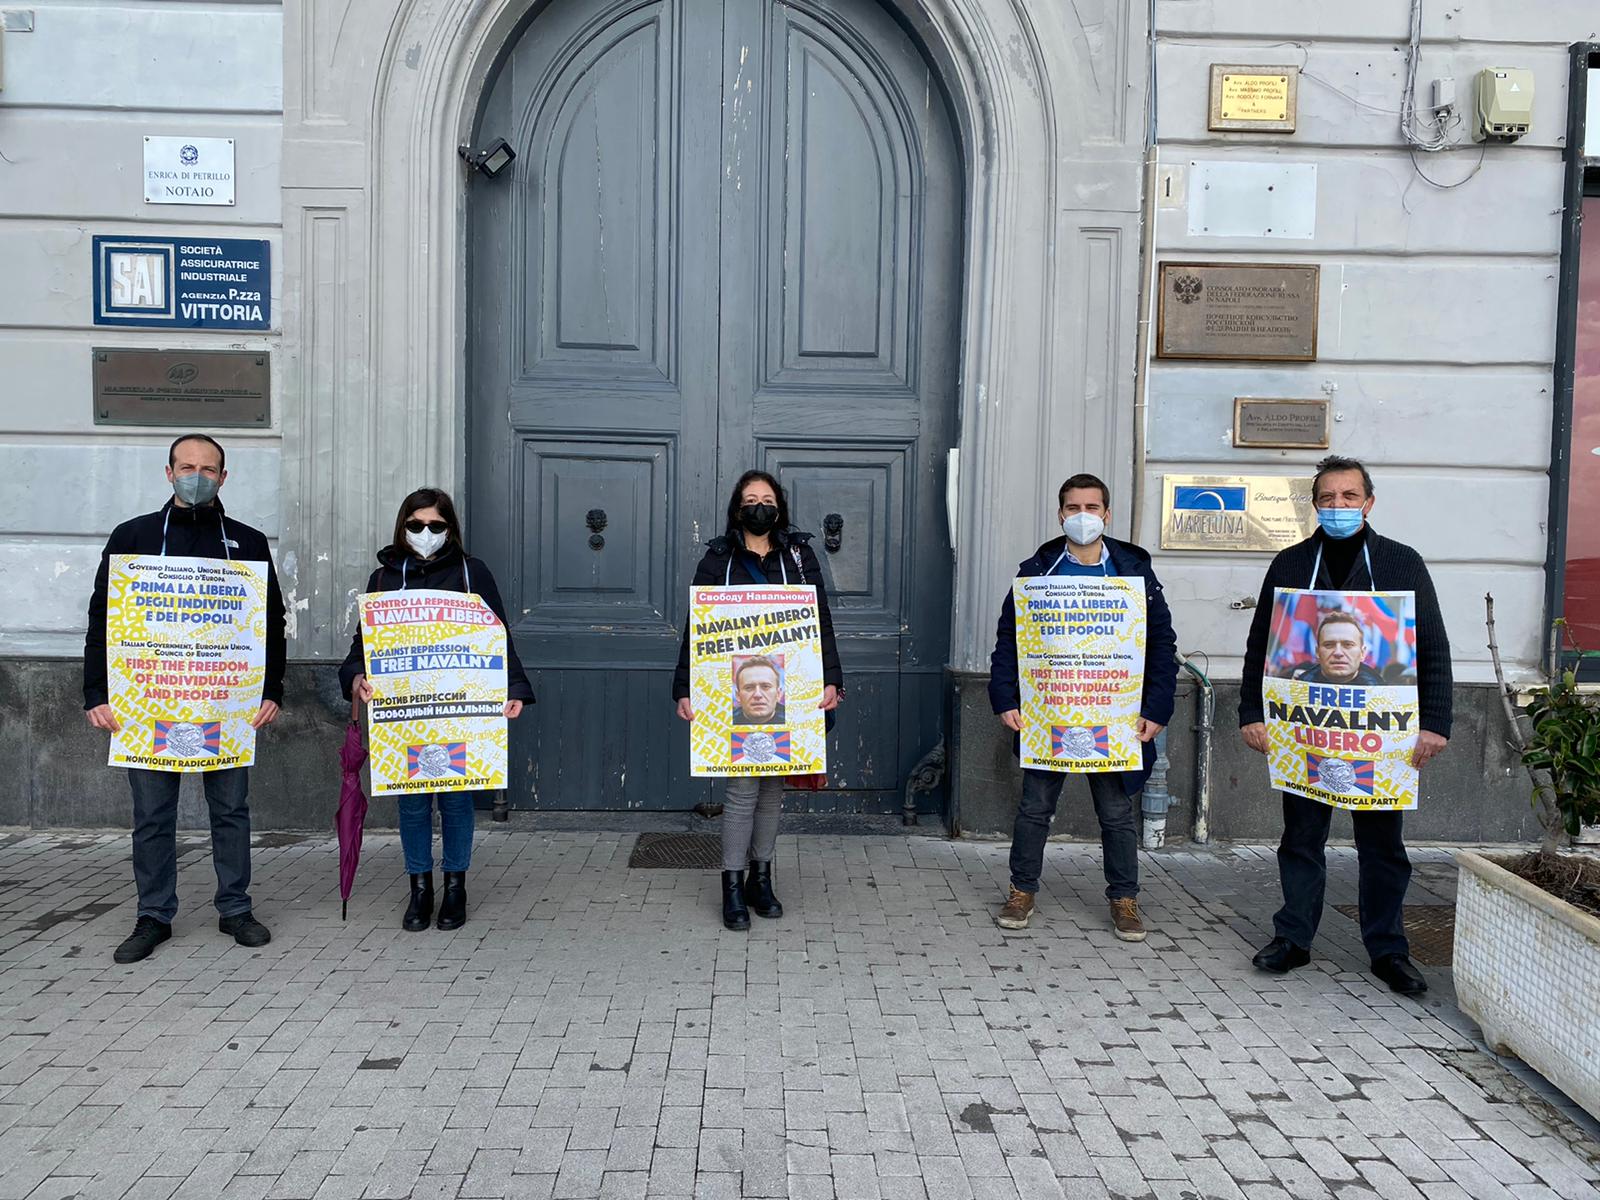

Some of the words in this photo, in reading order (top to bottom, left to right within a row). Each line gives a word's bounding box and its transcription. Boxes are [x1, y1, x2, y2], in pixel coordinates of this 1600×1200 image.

[149, 171, 178, 180] ENRICA
[181, 172, 190, 180] DI
[194, 172, 230, 181] PETRILLO
[166, 186, 214, 197] NOTAIO
[1165, 176, 1171, 197] 1
[180, 245, 222, 255] SOCIETÀ
[180, 259, 259, 269] ASSICURATRICE
[112, 255, 163, 306] SAI
[180, 272, 247, 282] INDUSTRIALE
[181, 292, 227, 300] AGENZIA
[229, 288, 261, 301] P.zza
[181, 303, 263, 321] VITTORIA
[1172, 513, 1244, 534] MARELUNA
[131, 582, 175, 593] PRIMA
[178, 583, 196, 594] LA
[200, 584, 247, 597] LIBERTÀ
[135, 596, 174, 607] DEGLI
[178, 598, 242, 610] INDIVIDUI
[365, 598, 407, 610] CONTRO
[411, 598, 422, 606] LA
[699, 593, 743, 602] Свободу
[747, 593, 813, 602] Навальному!
[1028, 600, 1062, 610] PRIMA
[1064, 600, 1079, 609] LA
[1082, 598, 1128, 609] LIBERTÀ
[146, 611, 152, 621] E
[156, 612, 177, 622] DEI
[181, 613, 232, 624] POPOLI
[374, 608, 440, 624] NAVALNY
[444, 609, 495, 624] LIBERO
[696, 614, 761, 635] NAVALNY
[764, 607, 815, 625] LIBERO!
[1032, 613, 1062, 623] DEGLI
[1064, 613, 1124, 622] INDIVIDUI
[1041, 627, 1045, 635] E
[1048, 626, 1065, 635] DEI
[1068, 626, 1114, 635] POPOLI
[697, 638, 734, 656] FREE
[738, 625, 818, 650] NAVALNY!
[154, 649, 183, 657] COUNCIL
[196, 650, 222, 658] EUROPE
[370, 646, 409, 658] AGAINST
[411, 645, 470, 655] REPRESSION
[126, 658, 158, 670] FIRST
[161, 660, 185, 671] THE
[188, 661, 249, 671] FREEDOM
[380, 658, 413, 673] FREE
[417, 655, 493, 670] NAVALNY
[135, 674, 152, 684] OF
[156, 675, 240, 686] INDIVIDUALS
[1031, 669, 1052, 679] FIRST
[1055, 670, 1074, 679] THE
[1077, 670, 1129, 679] FREEDOM
[144, 688, 171, 699] AND
[174, 690, 229, 700] PEOPLES
[1038, 683, 1048, 692] OF
[1051, 683, 1120, 693] INDIVIDUALS
[373, 696, 408, 706] ПРОТИВ
[410, 692, 466, 703] РЕПРЕССИЙ
[1044, 697, 1064, 706] AND
[1067, 697, 1112, 706] PEOPLES
[1309, 685, 1366, 708] FREE
[374, 705, 433, 720] СВОБОДНЫЙ
[436, 702, 503, 714] НАВАЛЬНЫЙ
[1269, 701, 1413, 731] NAVALNY
[1294, 726, 1383, 753] LIBERO
[126, 756, 177, 767] NONVIOLENT
[178, 757, 215, 767] RADICAL
[217, 756, 240, 765] PARTY
[1033, 758, 1073, 768] NONVIOLENT
[1075, 760, 1106, 768] RADICAL
[386, 782, 428, 790] NONVIOLENT
[464, 778, 490, 786] PARTY
[1285, 781, 1330, 800] NONVIOLENT
[1332, 795, 1369, 805] RADICAL
[1371, 798, 1399, 806] PARTY
